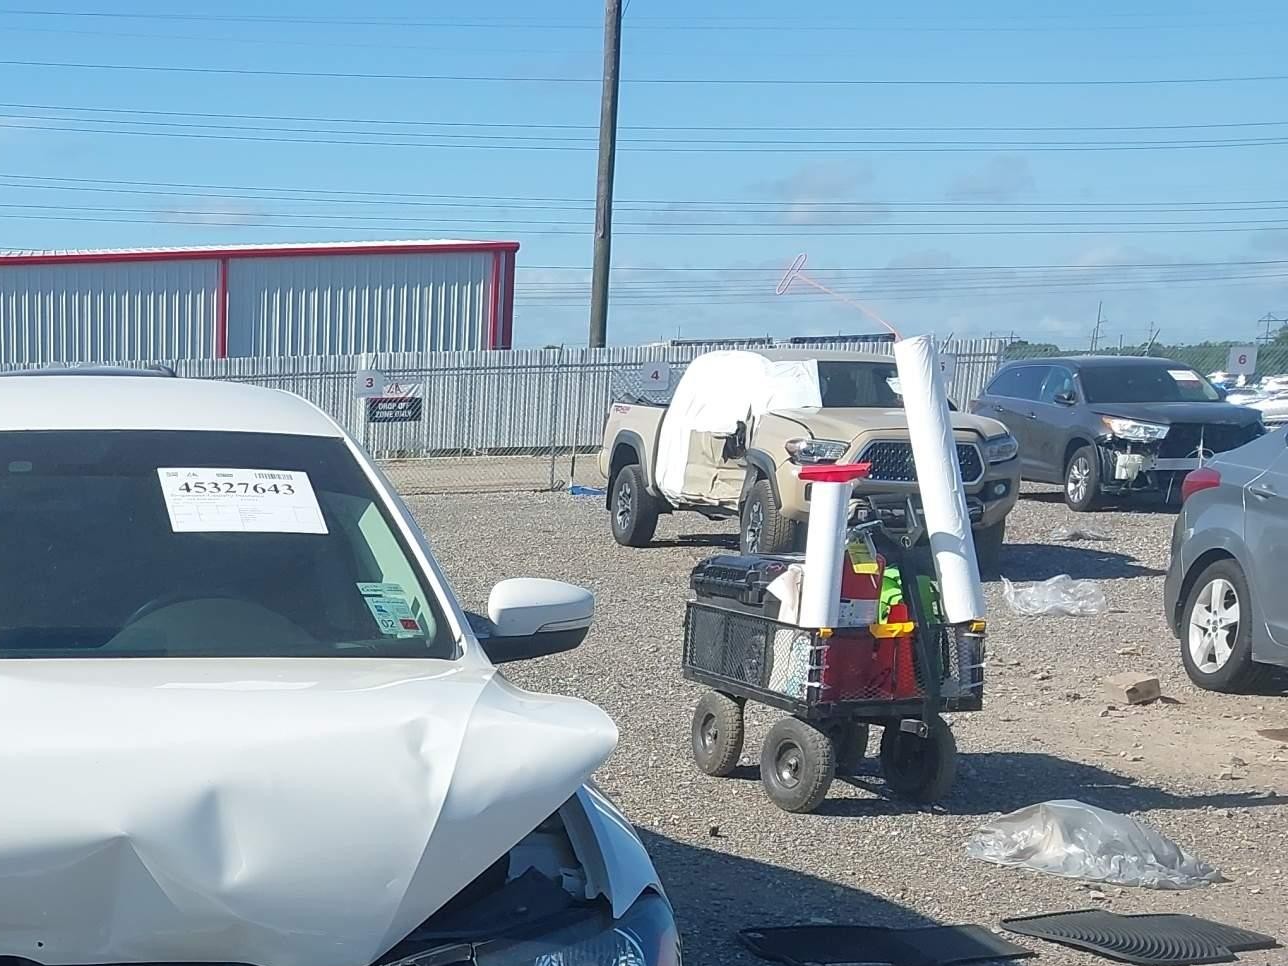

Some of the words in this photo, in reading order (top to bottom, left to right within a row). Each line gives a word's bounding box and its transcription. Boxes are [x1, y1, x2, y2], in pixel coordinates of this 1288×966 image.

[1238, 354, 1248, 365] 6
[650, 370, 660, 381] 4
[365, 377, 374, 388] 3
[378, 402, 396, 410] DROP
[178, 481, 296, 496] 45327643
